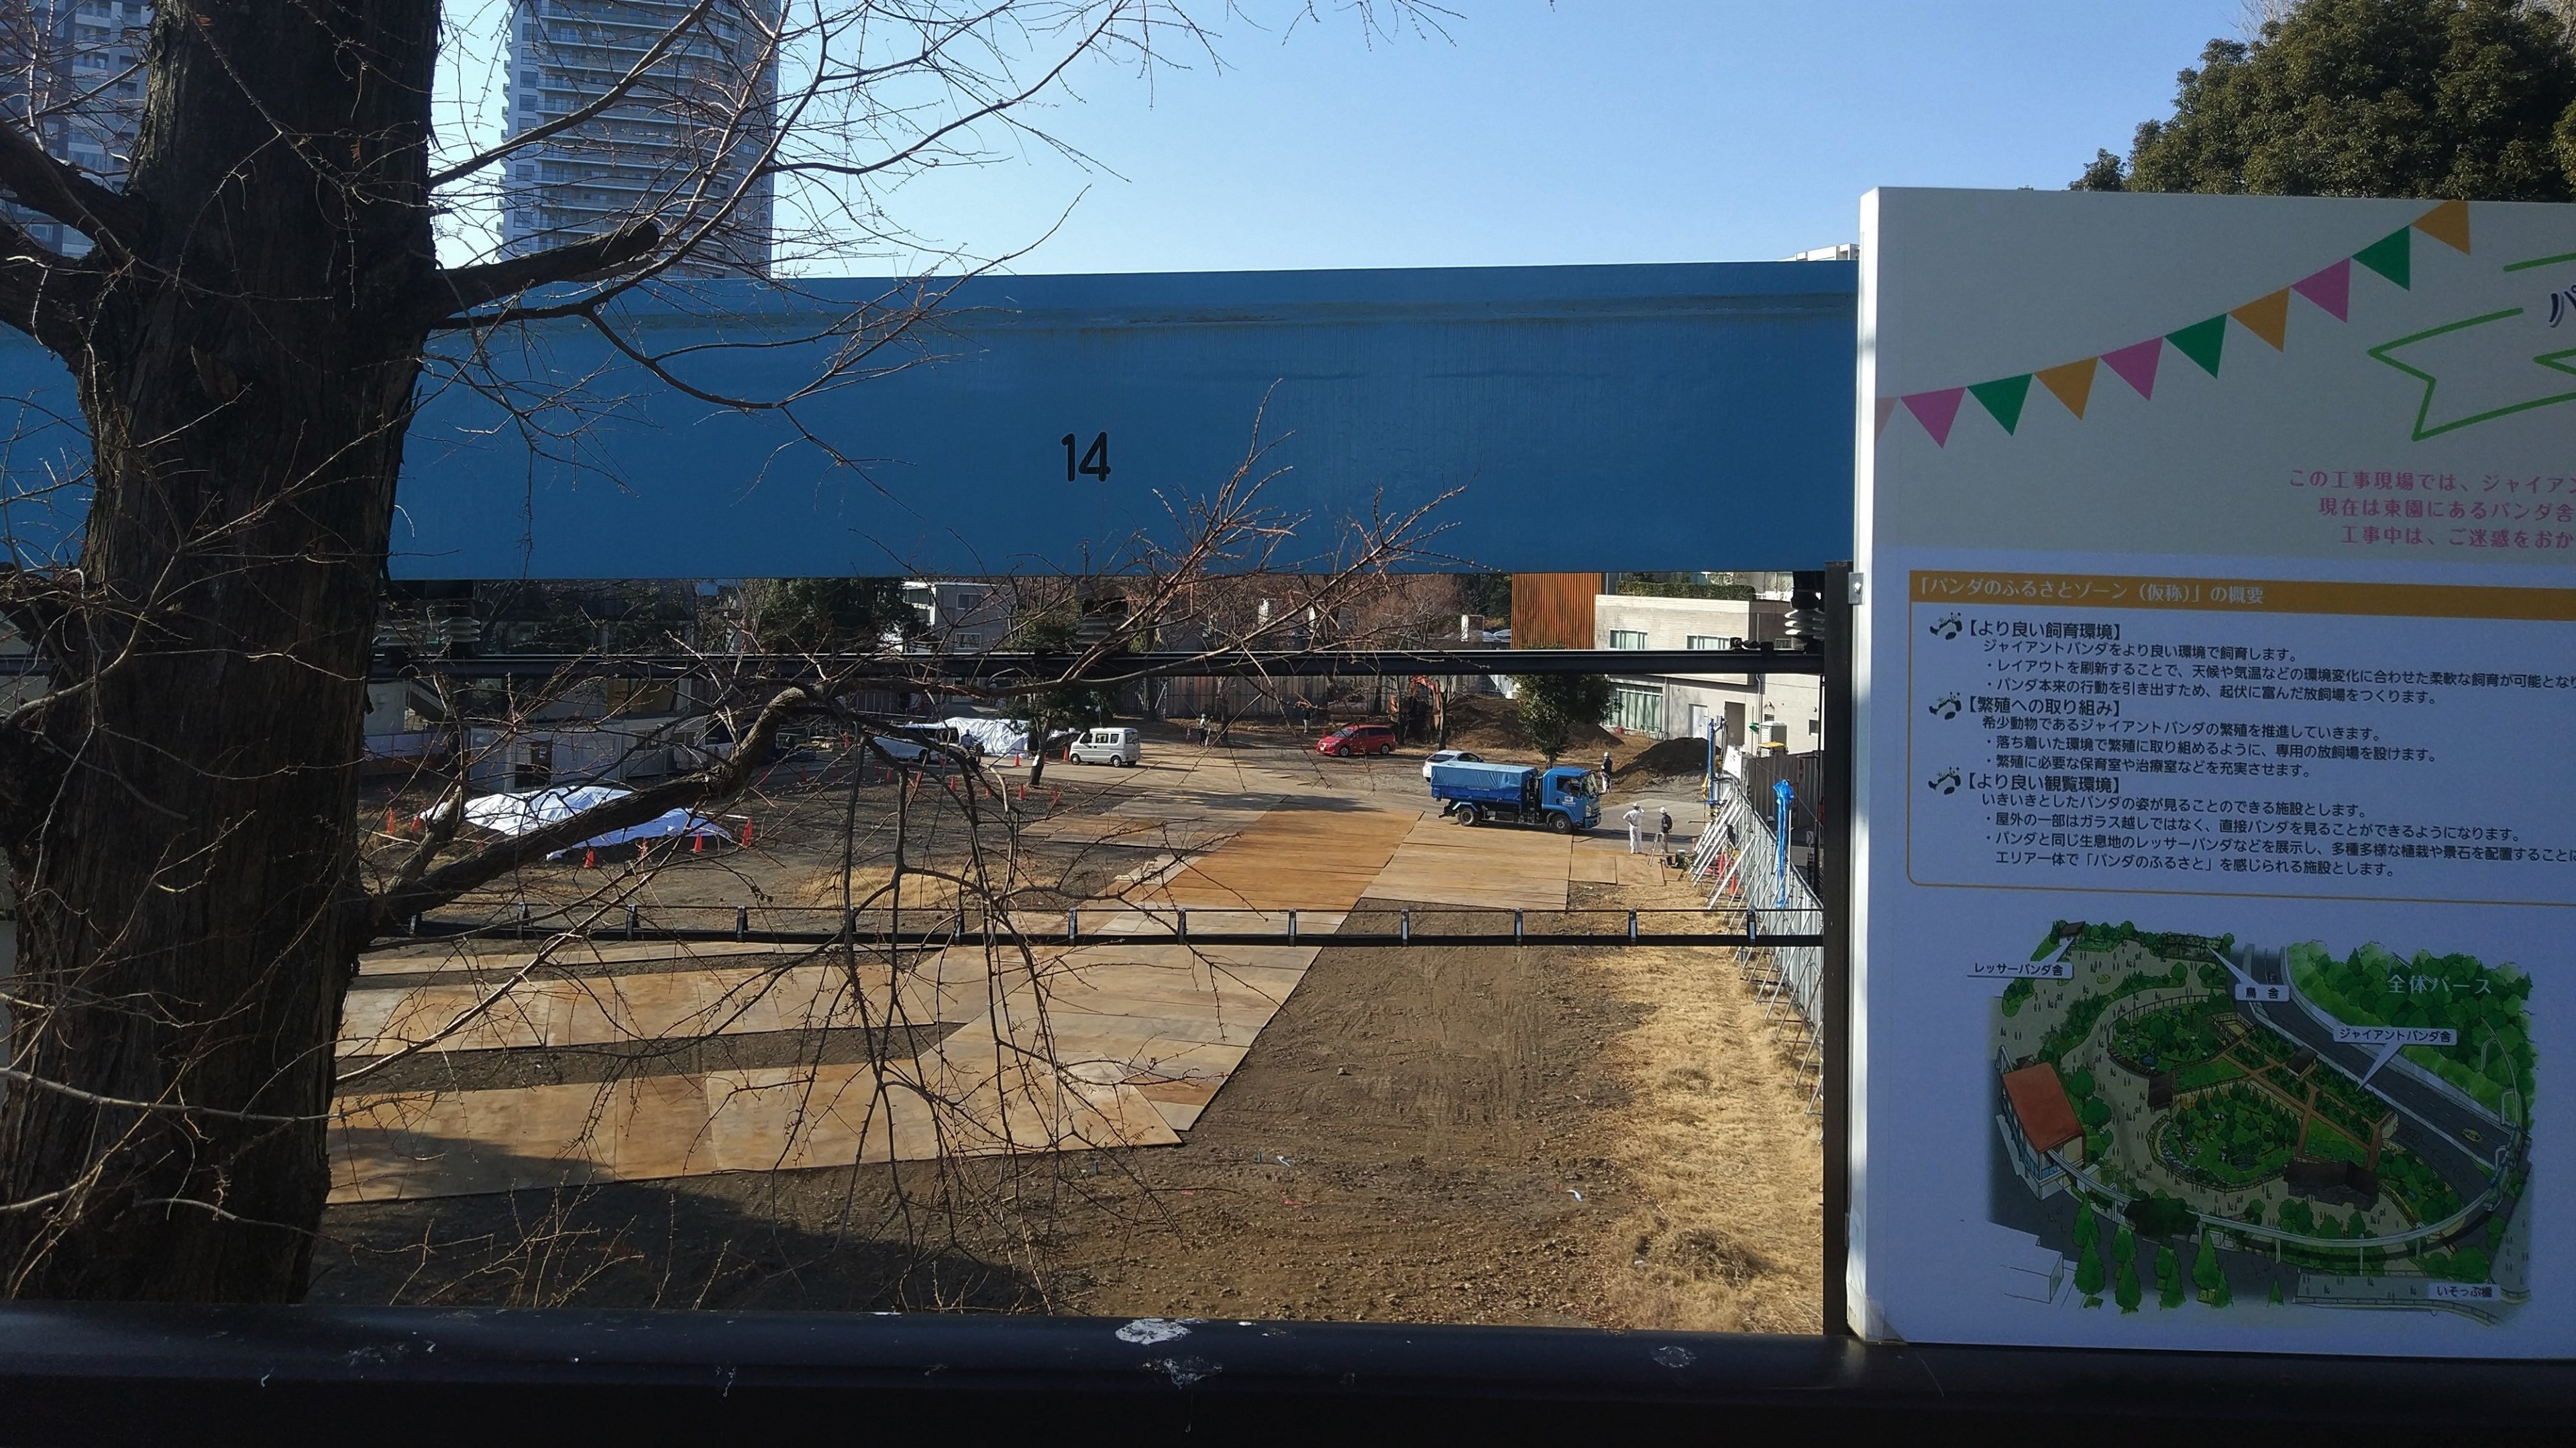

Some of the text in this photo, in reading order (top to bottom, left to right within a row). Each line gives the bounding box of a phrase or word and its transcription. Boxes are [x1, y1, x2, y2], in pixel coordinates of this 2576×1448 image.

[1061, 431, 1111, 482] 14
[2318, 498, 2574, 522] 現在は東園にあるパンダ舎
[2342, 526, 2574, 549] 工事中は、ご迷惑をおか
[1971, 620, 2119, 641] 【より良い飼育環境】
[1984, 639, 2295, 662] ジャイアントパンダをより良い環境で飼育します。
[1970, 695, 2119, 716] 【繁殖への取り組み】
[1983, 716, 2379, 741] 希少動物であるジャイアントパンダの繁殖を推進していきます。
[1970, 773, 2119, 794] 【より良い観覧環境】
[1983, 793, 2364, 818] いきいきとしたパンダの姿が見ることのできる施設とします。
[1974, 962, 2063, 977] レッサーパンダ舎
[2387, 974, 2491, 994] 全体パース
[2339, 1028, 2451, 1043] ジャイアントパンダ舎
